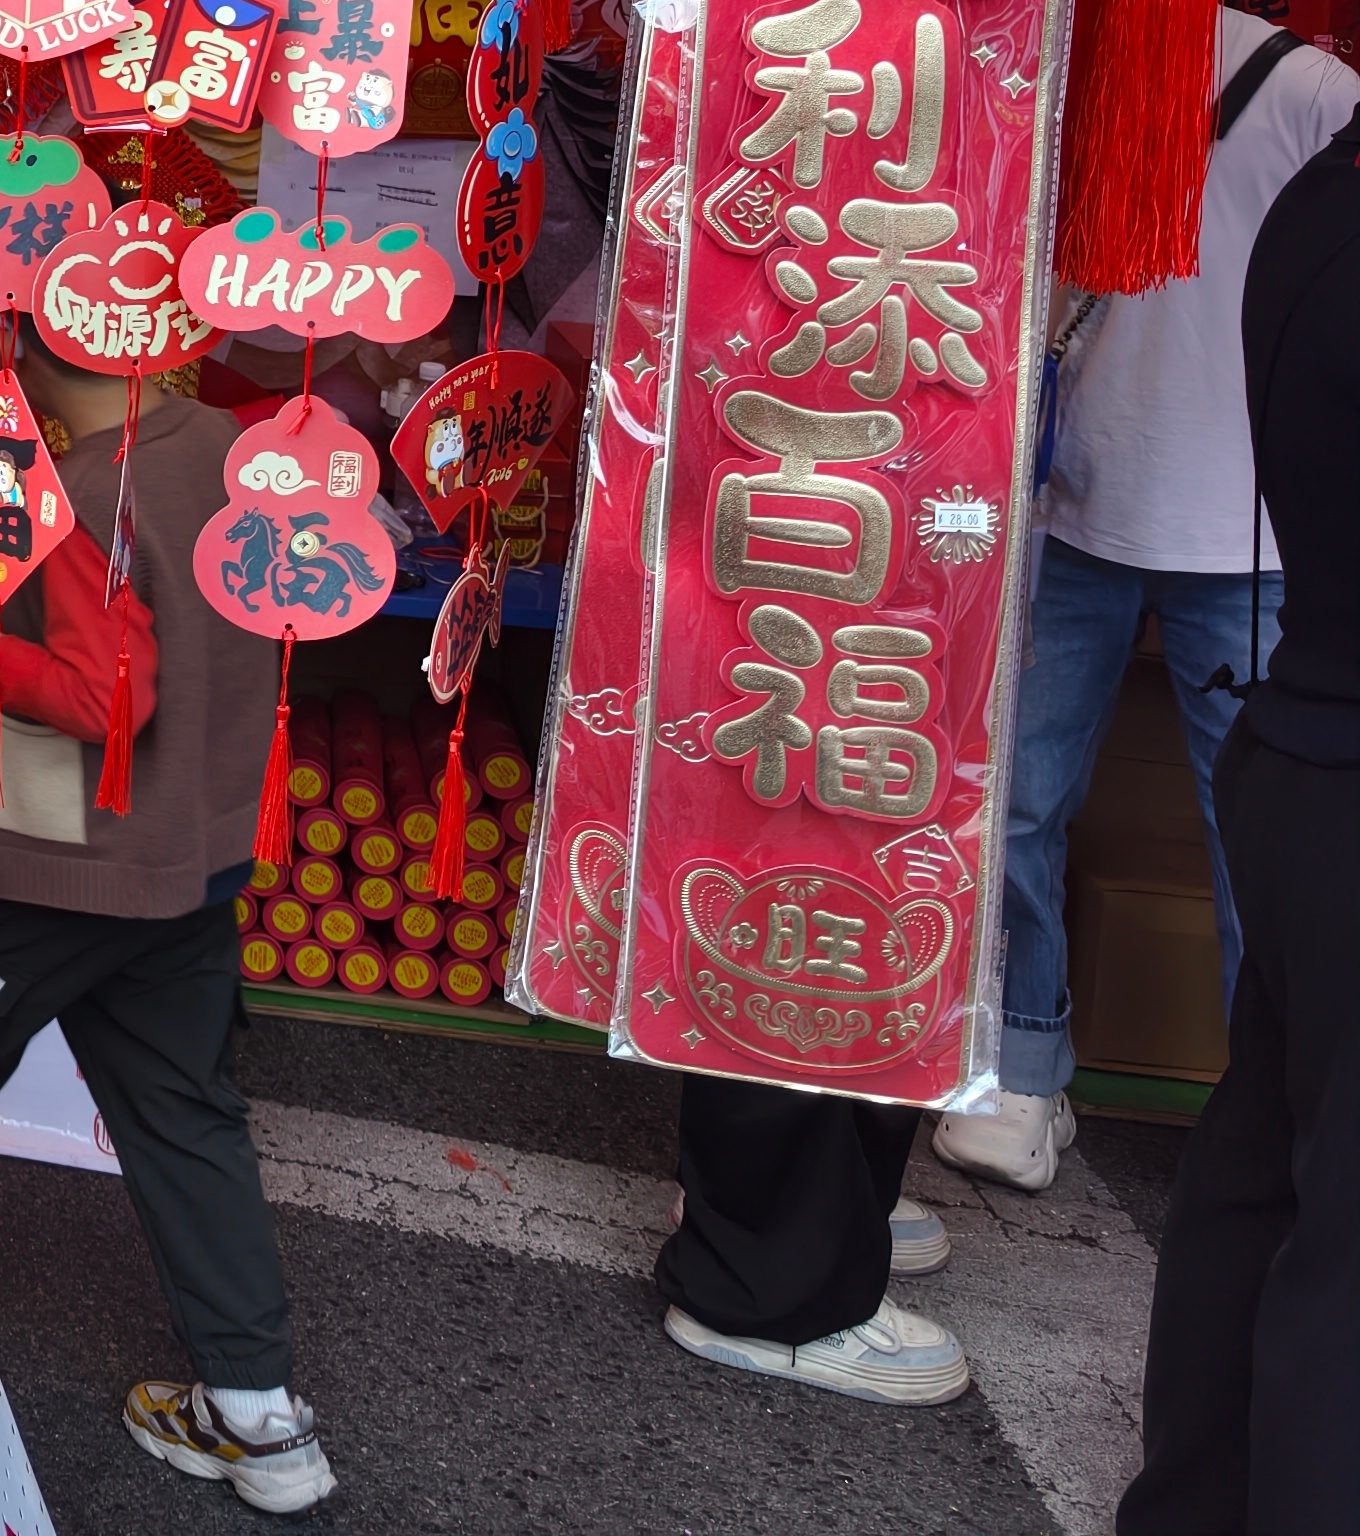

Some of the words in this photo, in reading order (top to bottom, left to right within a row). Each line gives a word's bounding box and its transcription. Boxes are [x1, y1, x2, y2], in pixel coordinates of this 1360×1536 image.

[204, 254, 422, 322] HAPPY
[333, 454, 357, 495] 福到
[949, 512, 980, 527] 28.00
[764, 902, 868, 985] 旺
